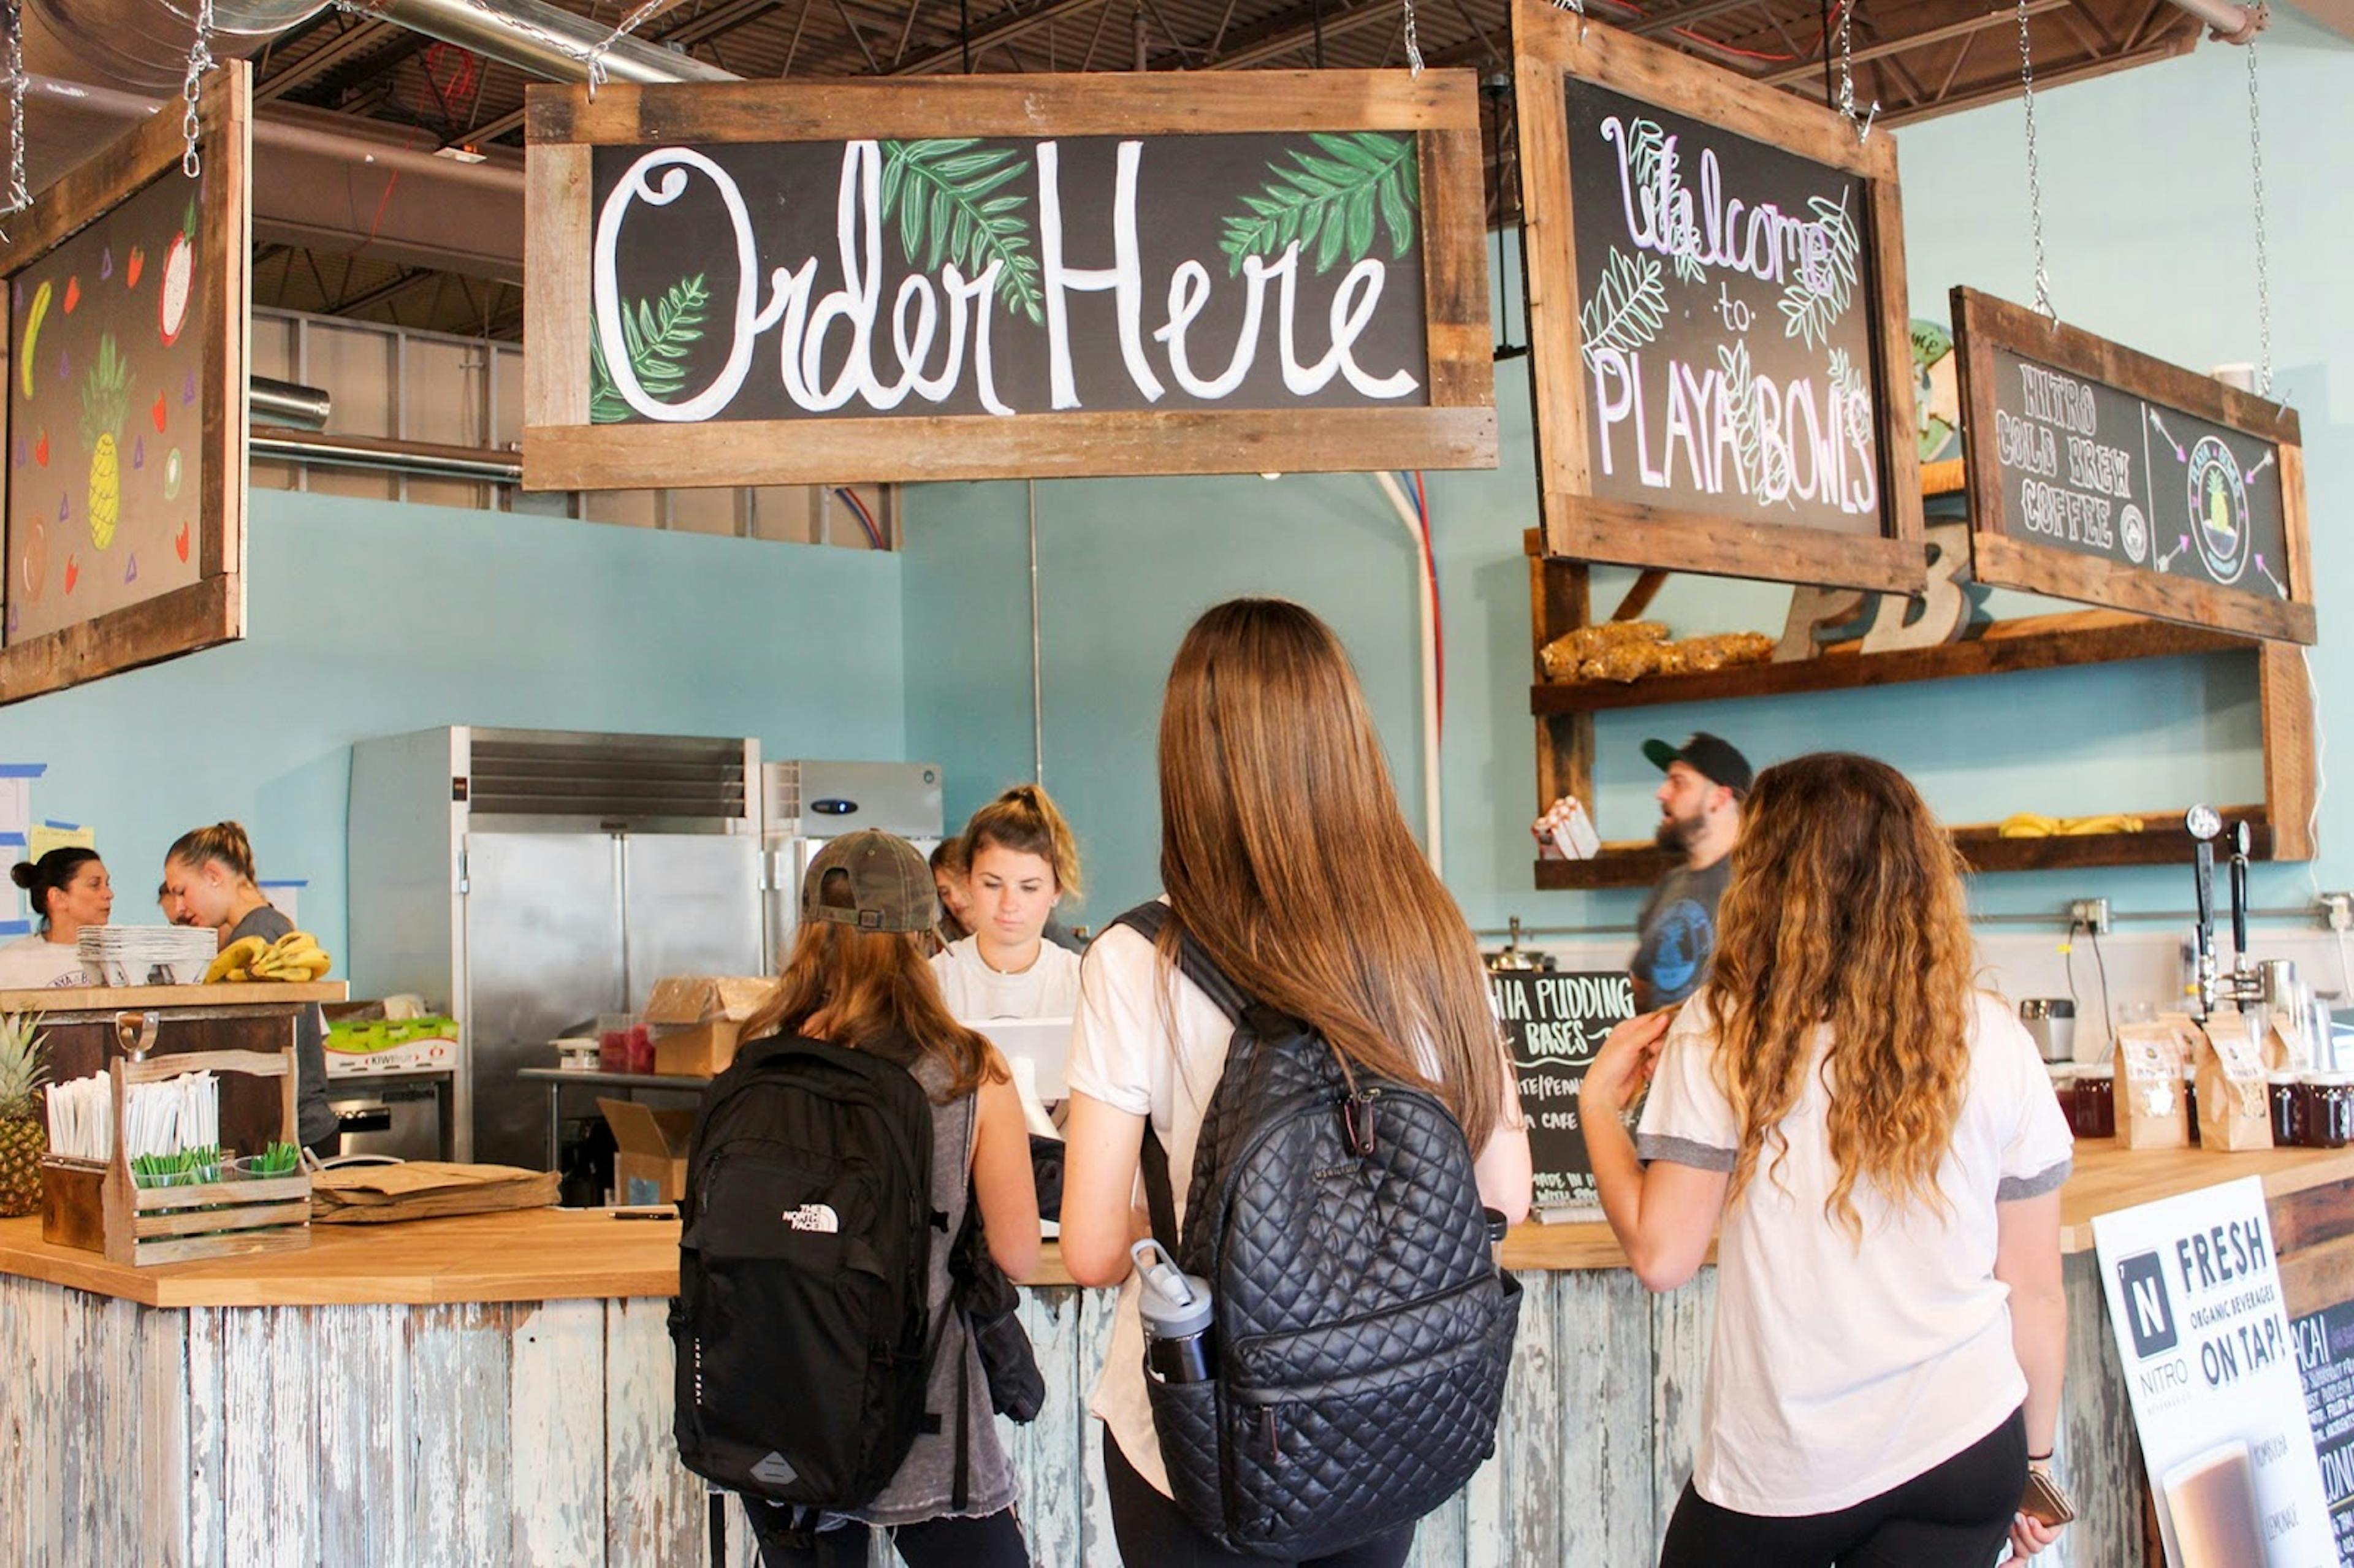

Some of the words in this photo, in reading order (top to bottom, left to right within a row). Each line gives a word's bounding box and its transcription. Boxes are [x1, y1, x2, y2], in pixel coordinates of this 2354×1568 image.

[1600, 116, 1834, 297] Welcome
[594, 140, 1016, 422] Order
[1036, 140, 1420, 409] Here
[1594, 348, 1748, 495] PLAYA
[1755, 374, 1876, 514] BOWLS
[2019, 363, 2097, 436] NITRO
[1996, 409, 2057, 478] COLD
[2067, 435, 2131, 498] BREW
[2022, 478, 2114, 549] COFFEE
[1492, 978, 1533, 1021] HIA
[1535, 976, 1637, 1019] PUDDING
[1525, 1019, 1589, 1056] BASES
[782, 1211, 820, 1221] NORTH
[791, 1221, 820, 1231] FACE
[2176, 1217, 2267, 1293] FRESH
[2131, 1276, 2166, 1338] N
[2190, 1300, 2231, 1330] ORGANIC
[2231, 1284, 2275, 1315] BEVERAGES
[2140, 1358, 2188, 1397] NITRO
[2201, 1334, 2238, 1385] ON
[2238, 1313, 2285, 1371] TAP!
